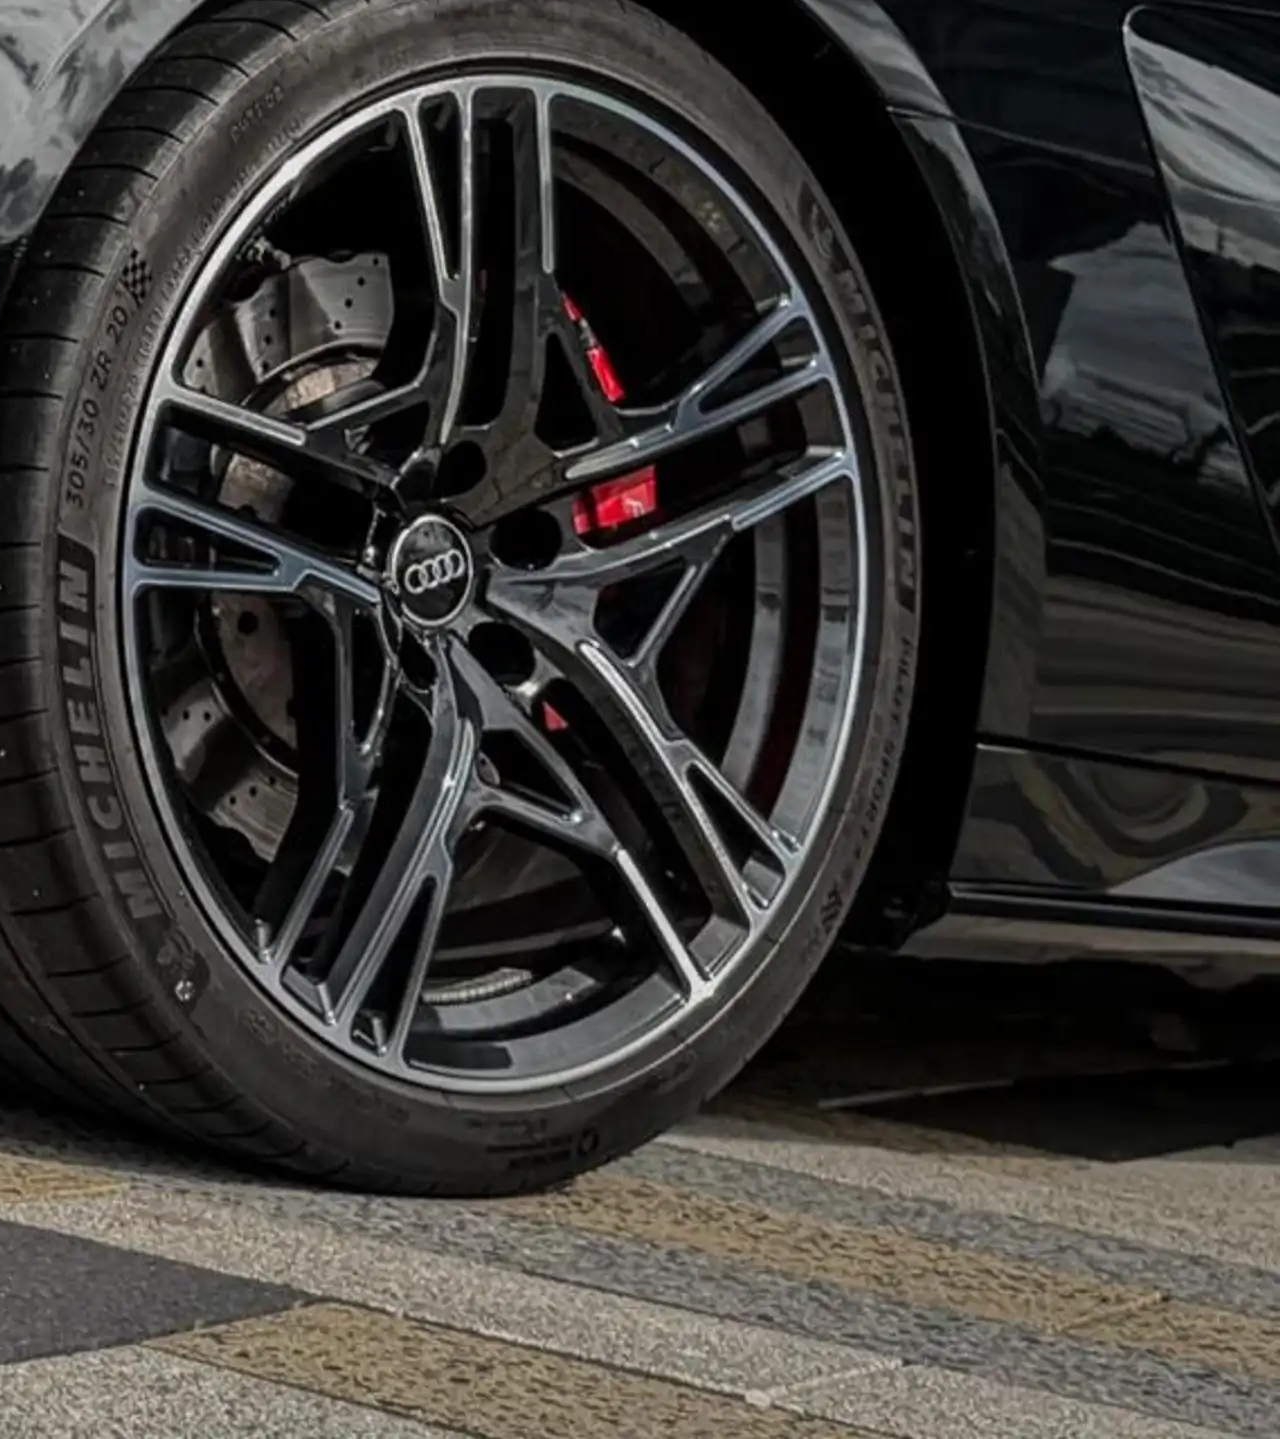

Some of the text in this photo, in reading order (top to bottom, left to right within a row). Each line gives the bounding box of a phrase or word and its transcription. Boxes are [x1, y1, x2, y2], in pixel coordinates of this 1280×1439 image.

[64, 398, 101, 509] 305/30
[90, 351, 114, 394] ZR
[107, 304, 129, 345] 20
[59, 560, 161, 919] MICHELIN
